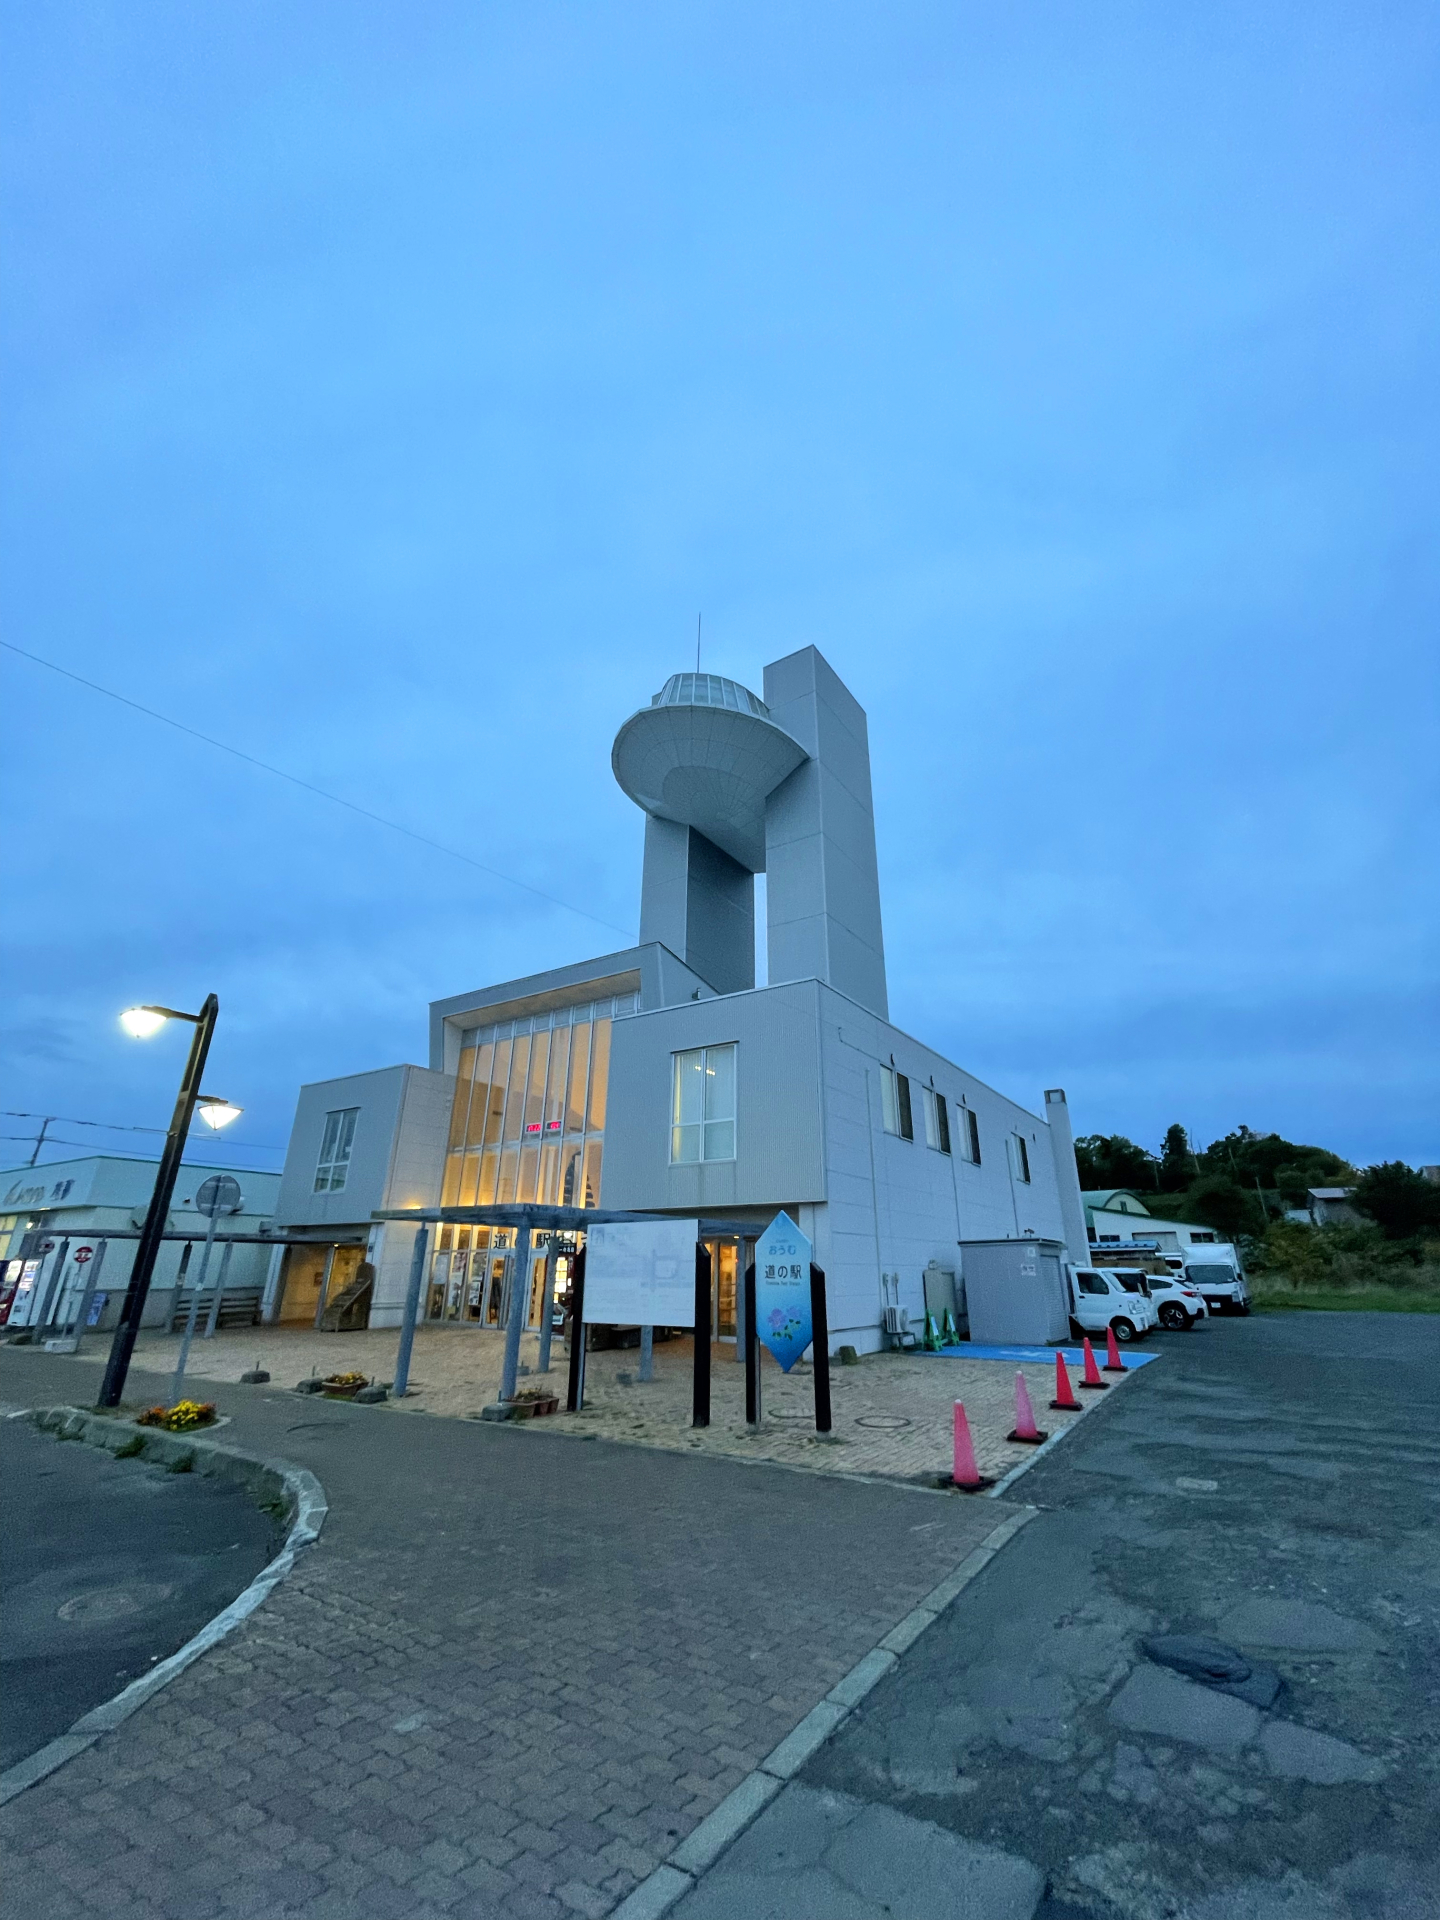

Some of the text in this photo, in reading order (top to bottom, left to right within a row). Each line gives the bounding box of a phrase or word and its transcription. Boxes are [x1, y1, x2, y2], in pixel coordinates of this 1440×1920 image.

[768, 1244, 796, 1256] おうむ
[764, 1264, 802, 1279] 道の駅
